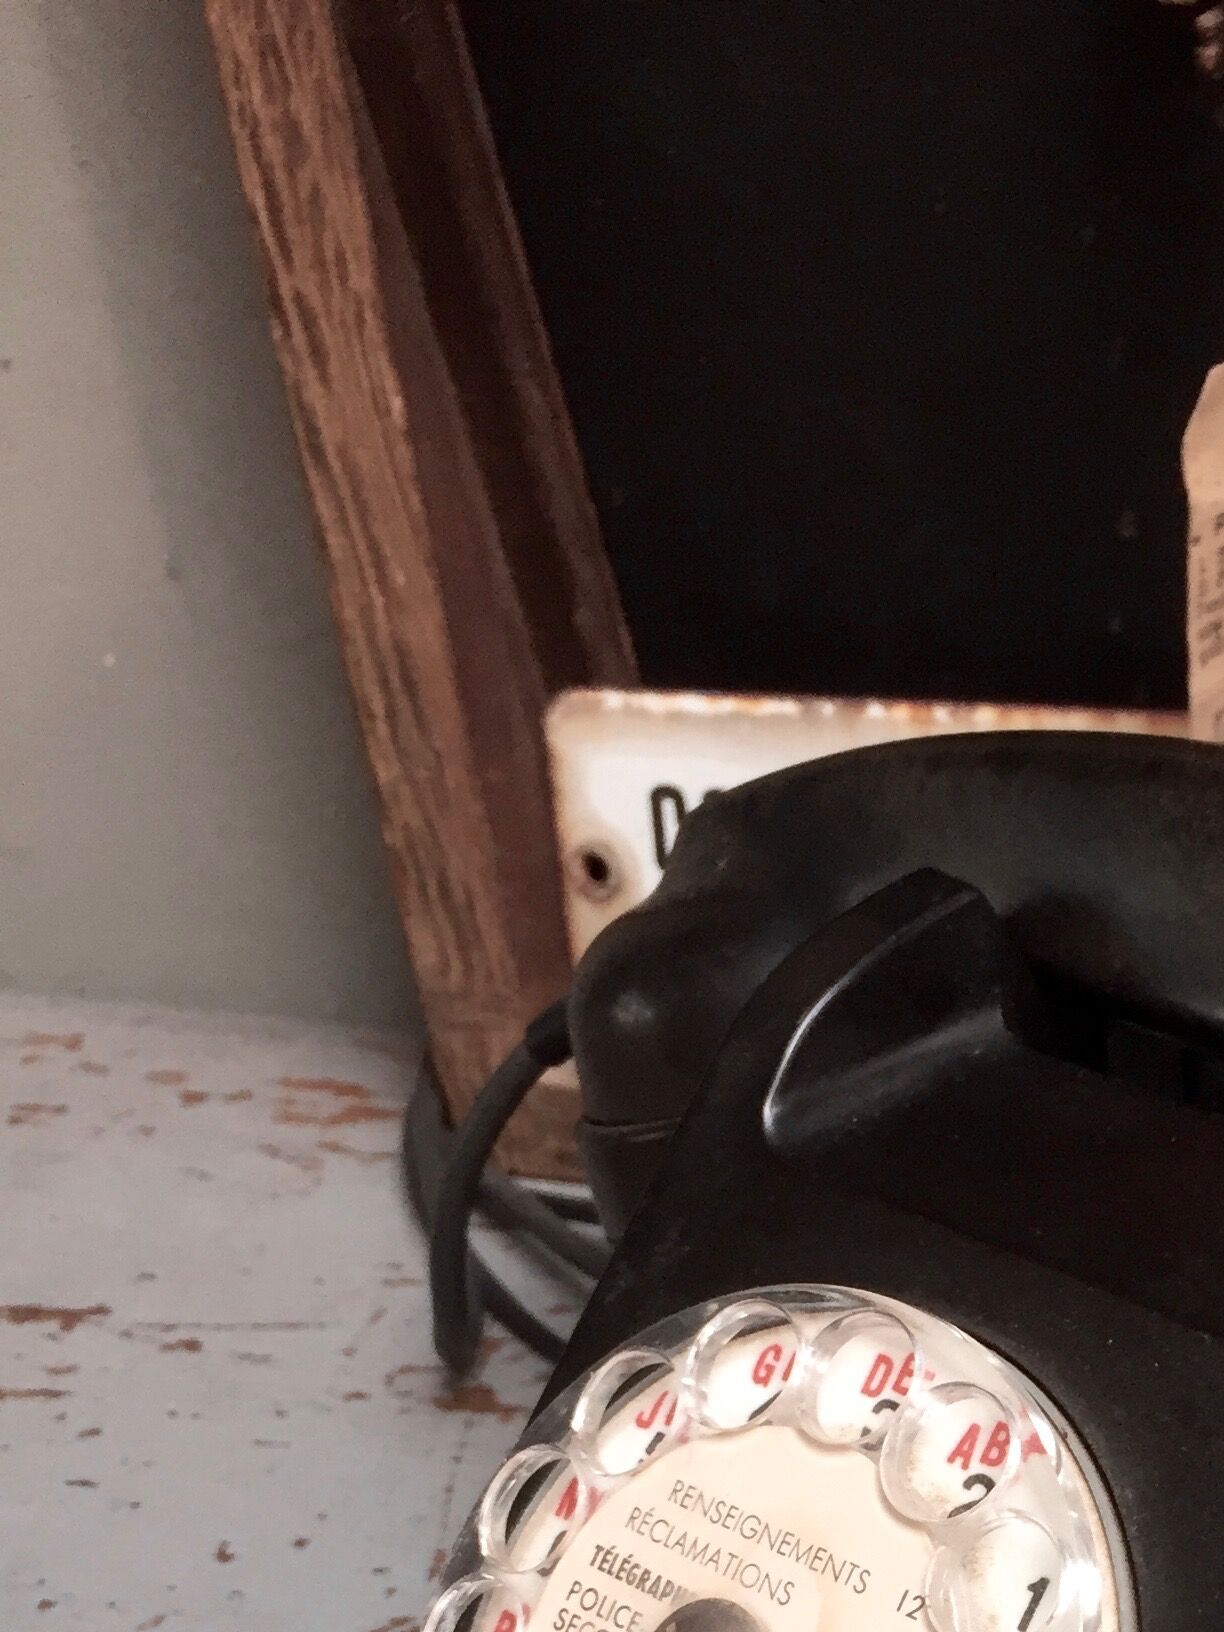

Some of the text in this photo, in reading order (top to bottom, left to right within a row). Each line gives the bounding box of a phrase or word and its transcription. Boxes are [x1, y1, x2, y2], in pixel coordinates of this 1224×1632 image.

[624, 1505, 796, 1606] RÉCLAMATIONS
[667, 1479, 872, 1594] RENSEIGNEMENTS
[896, 1589, 926, 1621] 12
